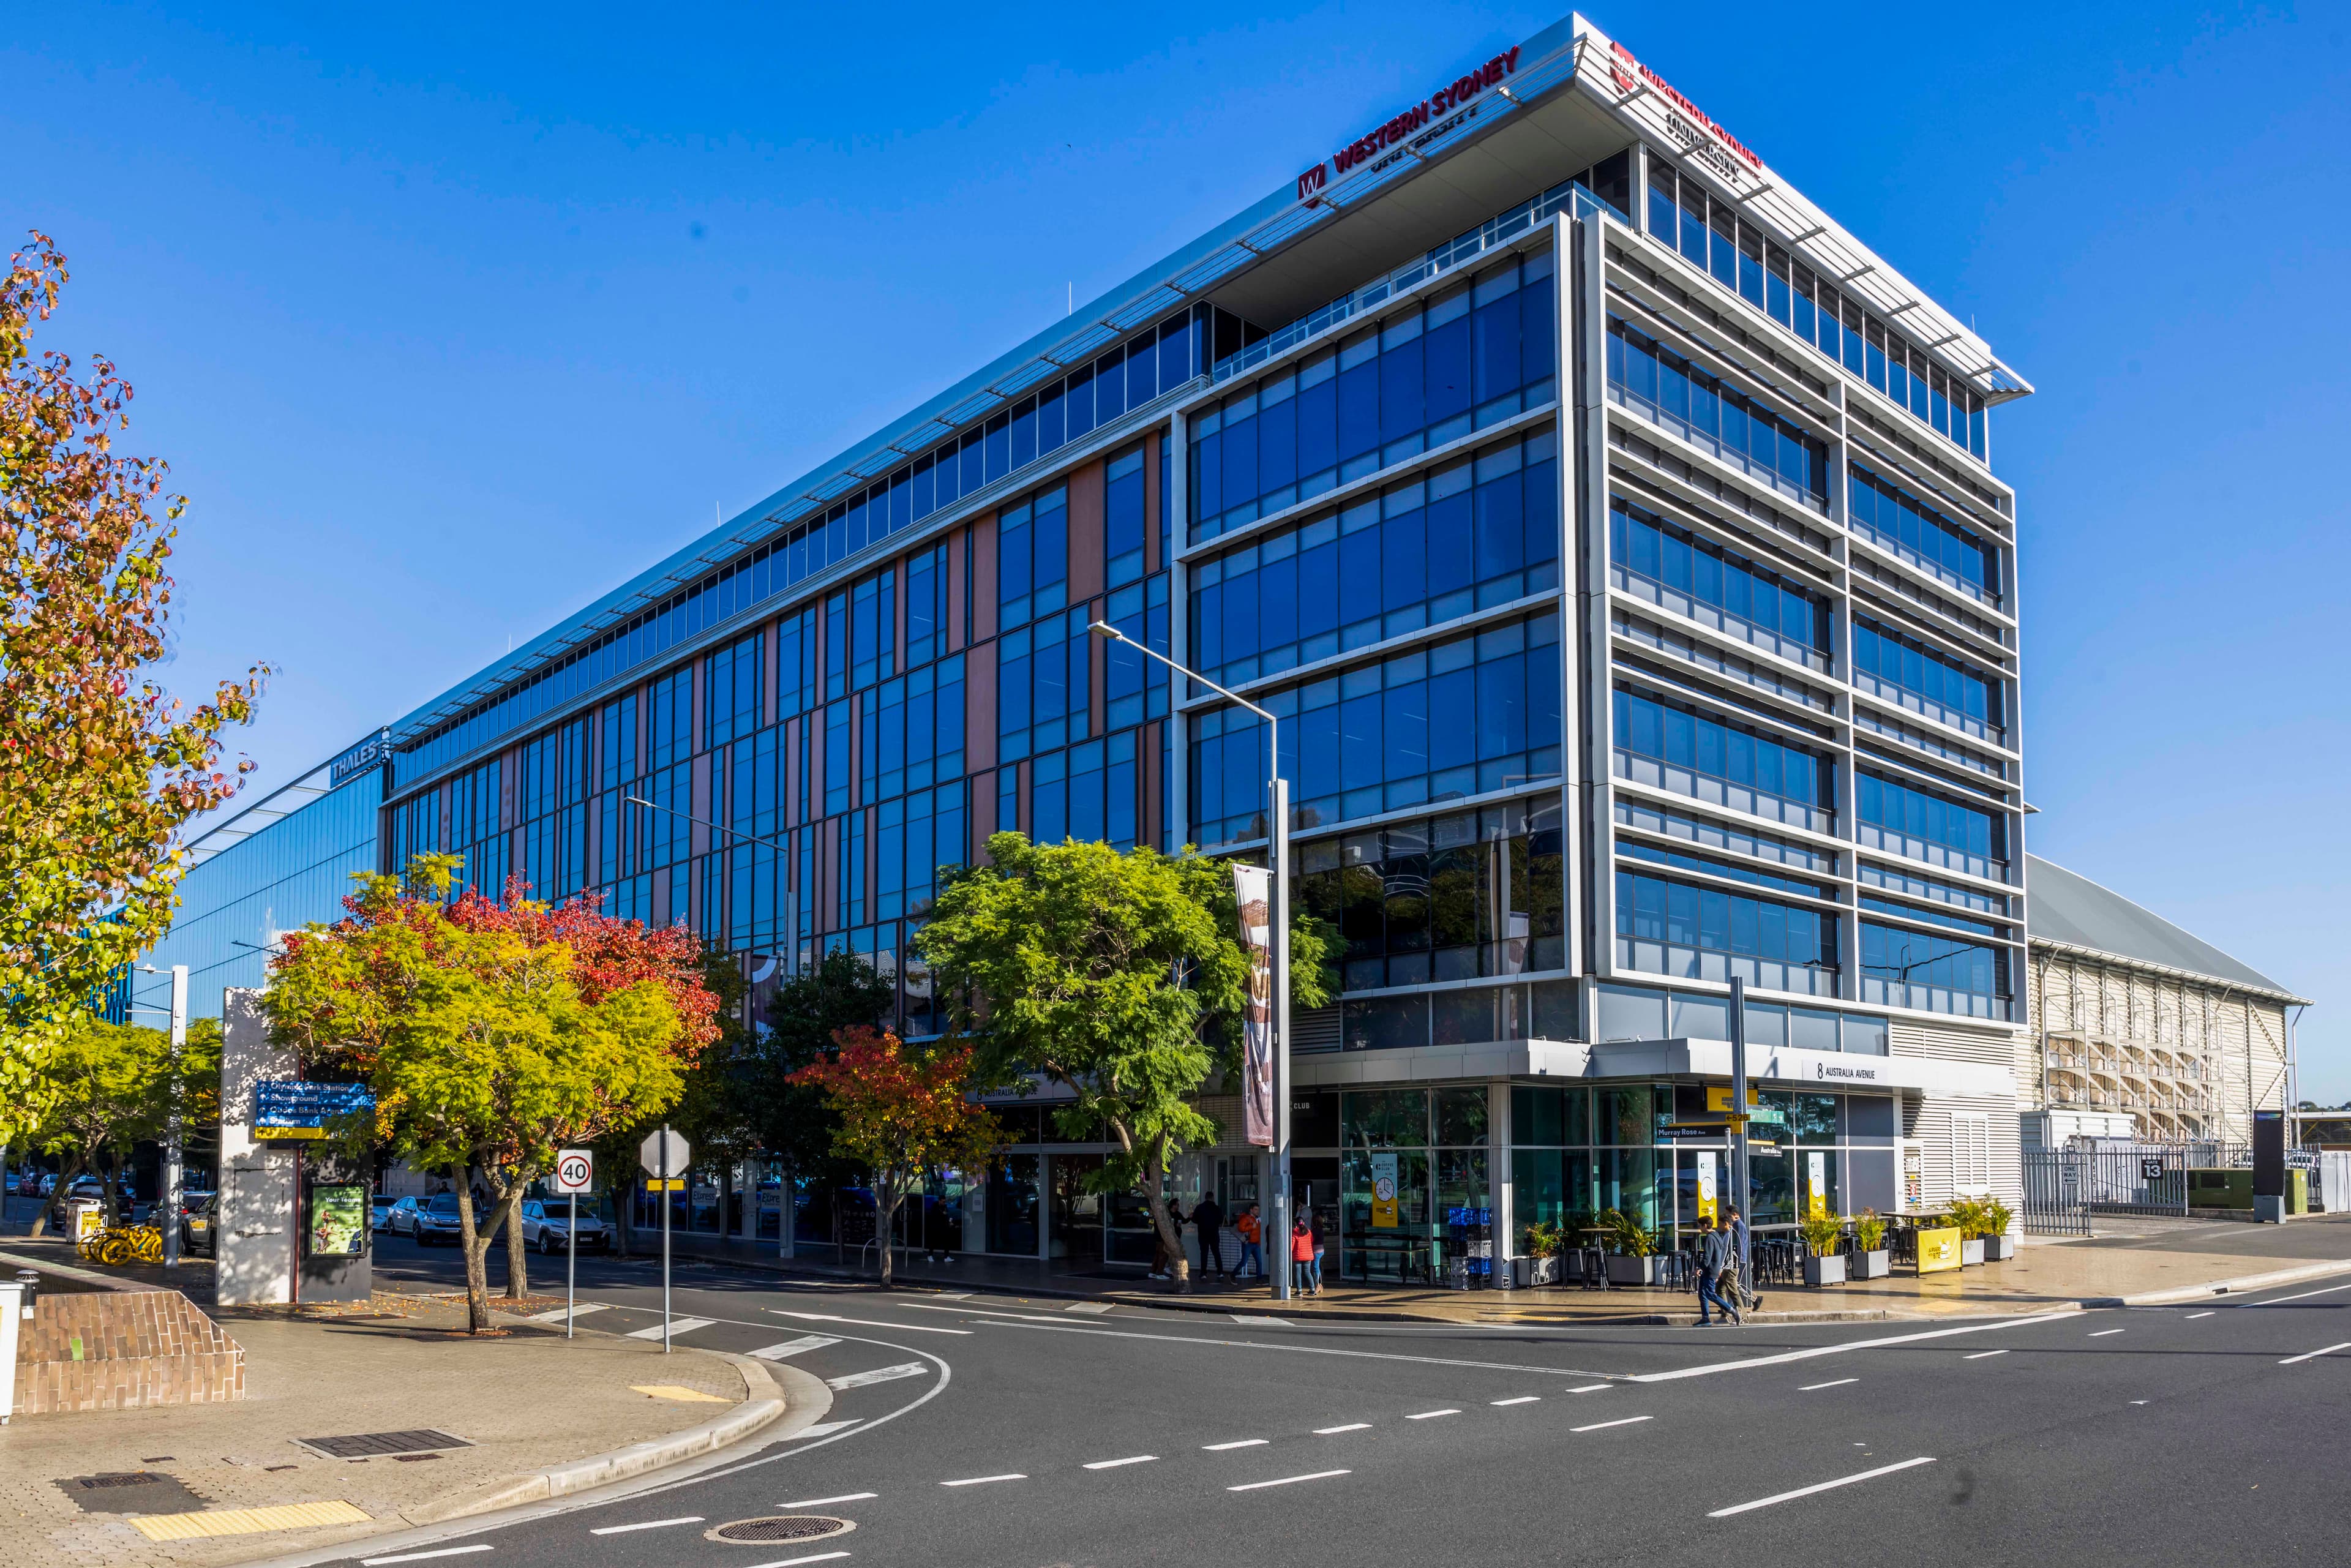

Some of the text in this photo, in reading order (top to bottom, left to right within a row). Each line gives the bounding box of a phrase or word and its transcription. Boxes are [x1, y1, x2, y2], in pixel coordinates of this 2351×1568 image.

[1333, 45, 1520, 174] WESTERN SYDNEY
[332, 740, 378, 779] THALES
[1817, 1062, 1875, 1079] 8 AUSTRALIA AVENUE
[271, 1082, 302, 1091] Olympic
[271, 1093, 318, 1104] Showground
[984, 1089, 1014, 1097] AUSTRALIA
[269, 1116, 301, 1125] Stadium
[563, 1163, 587, 1179] 40
[2144, 1165, 2161, 1177] 13
